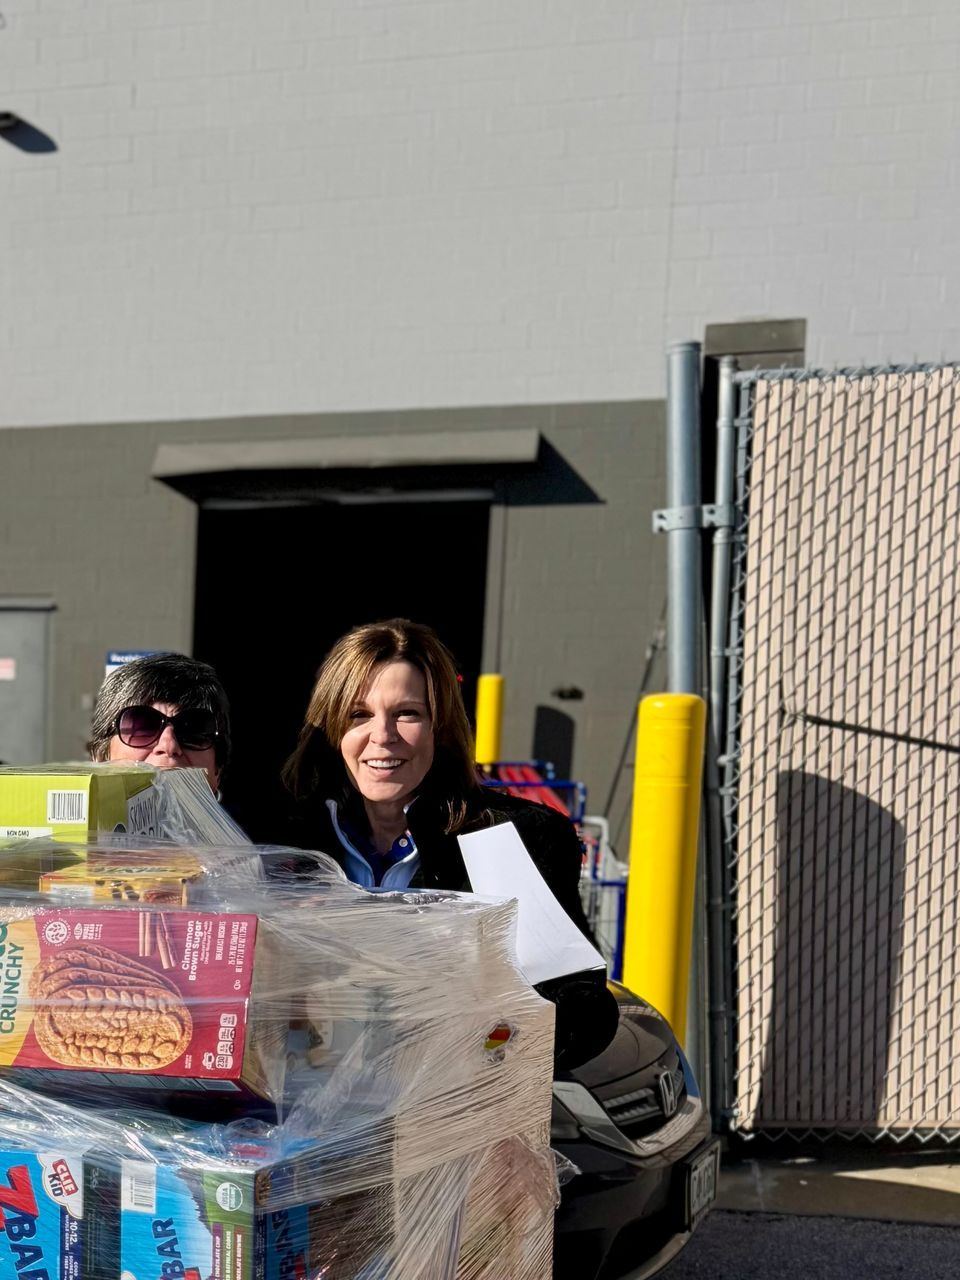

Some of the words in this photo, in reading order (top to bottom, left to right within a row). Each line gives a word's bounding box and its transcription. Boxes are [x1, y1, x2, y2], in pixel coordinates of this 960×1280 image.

[181, 920, 195, 971] Cinnamon
[191, 920, 203, 949] Sugar
[188, 950, 199, 981] Brown
[51, 1158, 79, 1197] CLIF
